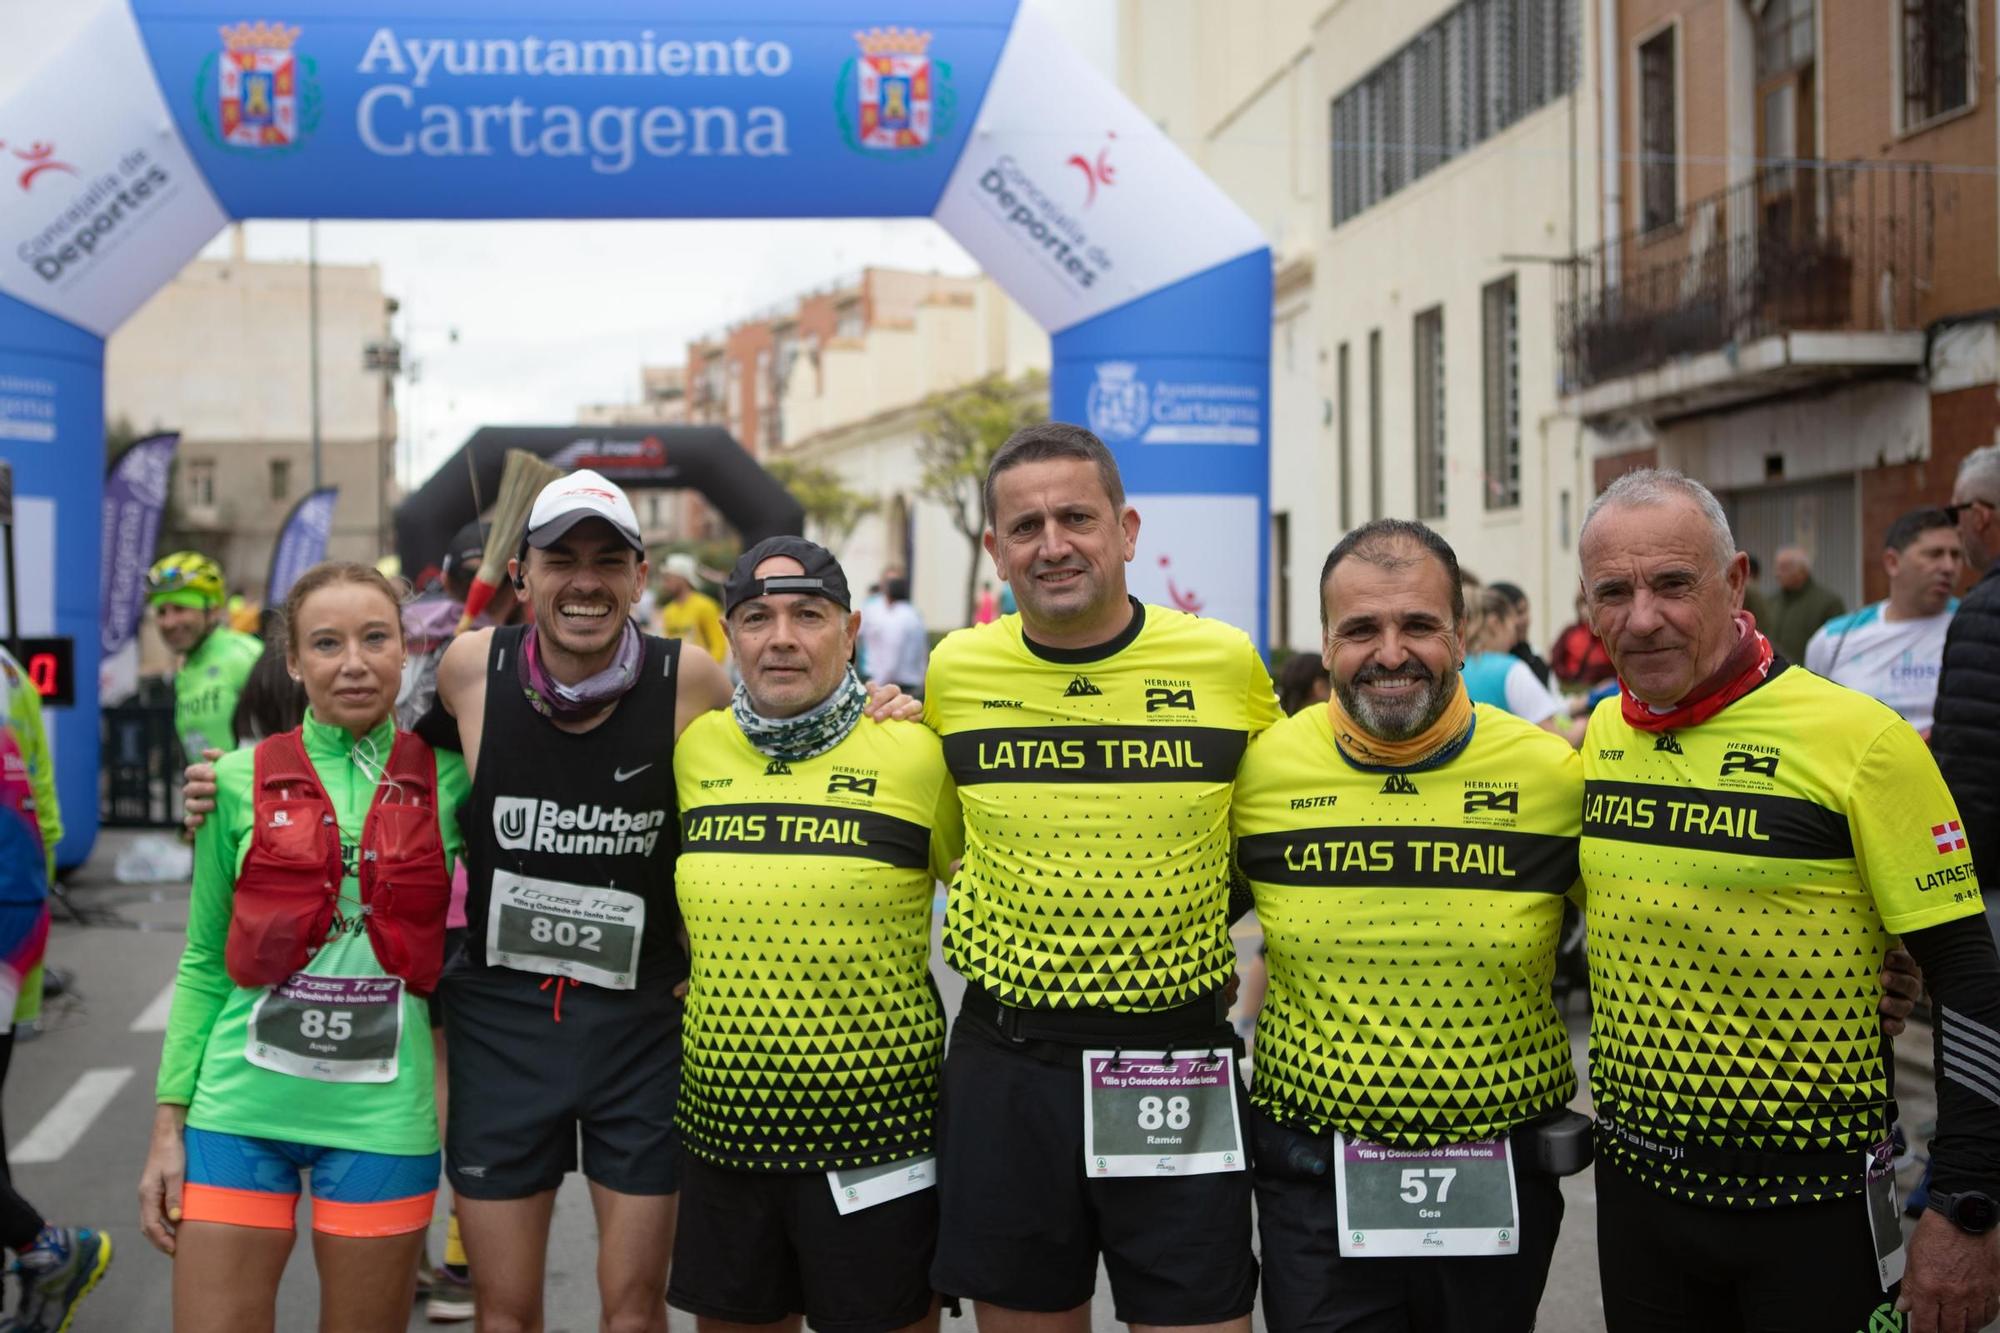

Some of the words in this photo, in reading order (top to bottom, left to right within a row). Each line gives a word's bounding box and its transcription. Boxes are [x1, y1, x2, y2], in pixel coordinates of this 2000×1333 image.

[357, 27, 793, 87] Ayuntamiento
[356, 83, 791, 174] Cartagena
[32, 164, 168, 283] Deportes
[979, 167, 1097, 289] Deportes
[1145, 679, 1192, 688] HERBALIFE
[1146, 689, 1195, 713] 24
[979, 741, 1085, 769] LATAS
[1097, 740, 1203, 769] TRAIL
[1599, 750, 1624, 760] ASTER
[1727, 742, 1781, 756] HERBALIFE
[832, 765, 879, 777] HERBALIFE
[1720, 751, 1780, 778] 24
[827, 774, 877, 797] 24
[1464, 781, 1519, 789] HERBALIFE
[1290, 796, 1338, 810] FASTER
[1463, 790, 1519, 814] 24
[539, 800, 666, 832] BeUrban
[1585, 793, 1657, 829] LATAS
[1667, 801, 1770, 841] TRAIL
[534, 826, 659, 858] Running
[688, 815, 767, 842] LATAS
[776, 816, 868, 846] TRAIL
[1284, 841, 1394, 872] LATAS
[1407, 841, 1516, 877] TRAIL
[523, 889, 582, 906] Cross
[530, 916, 602, 953] 802
[300, 1009, 353, 1041] 85
[1111, 1061, 1179, 1073] Cross
[1189, 1060, 1225, 1073] Trail
[1101, 1077, 1119, 1086] Villa
[1121, 1077, 1127, 1088] y
[1128, 1076, 1168, 1087] Condado
[1170, 1076, 1181, 1086] de
[1137, 1096, 1191, 1130] 88
[1146, 1135, 1183, 1145] Ramón
[1357, 1149, 1378, 1159] Villa
[1379, 1150, 1386, 1160] y
[1387, 1148, 1430, 1159] Condado
[1431, 1148, 1444, 1157] de
[1445, 1147, 1469, 1157] Santa
[1400, 1168, 1457, 1204] 57
[1419, 1209, 1441, 1218] Gea
